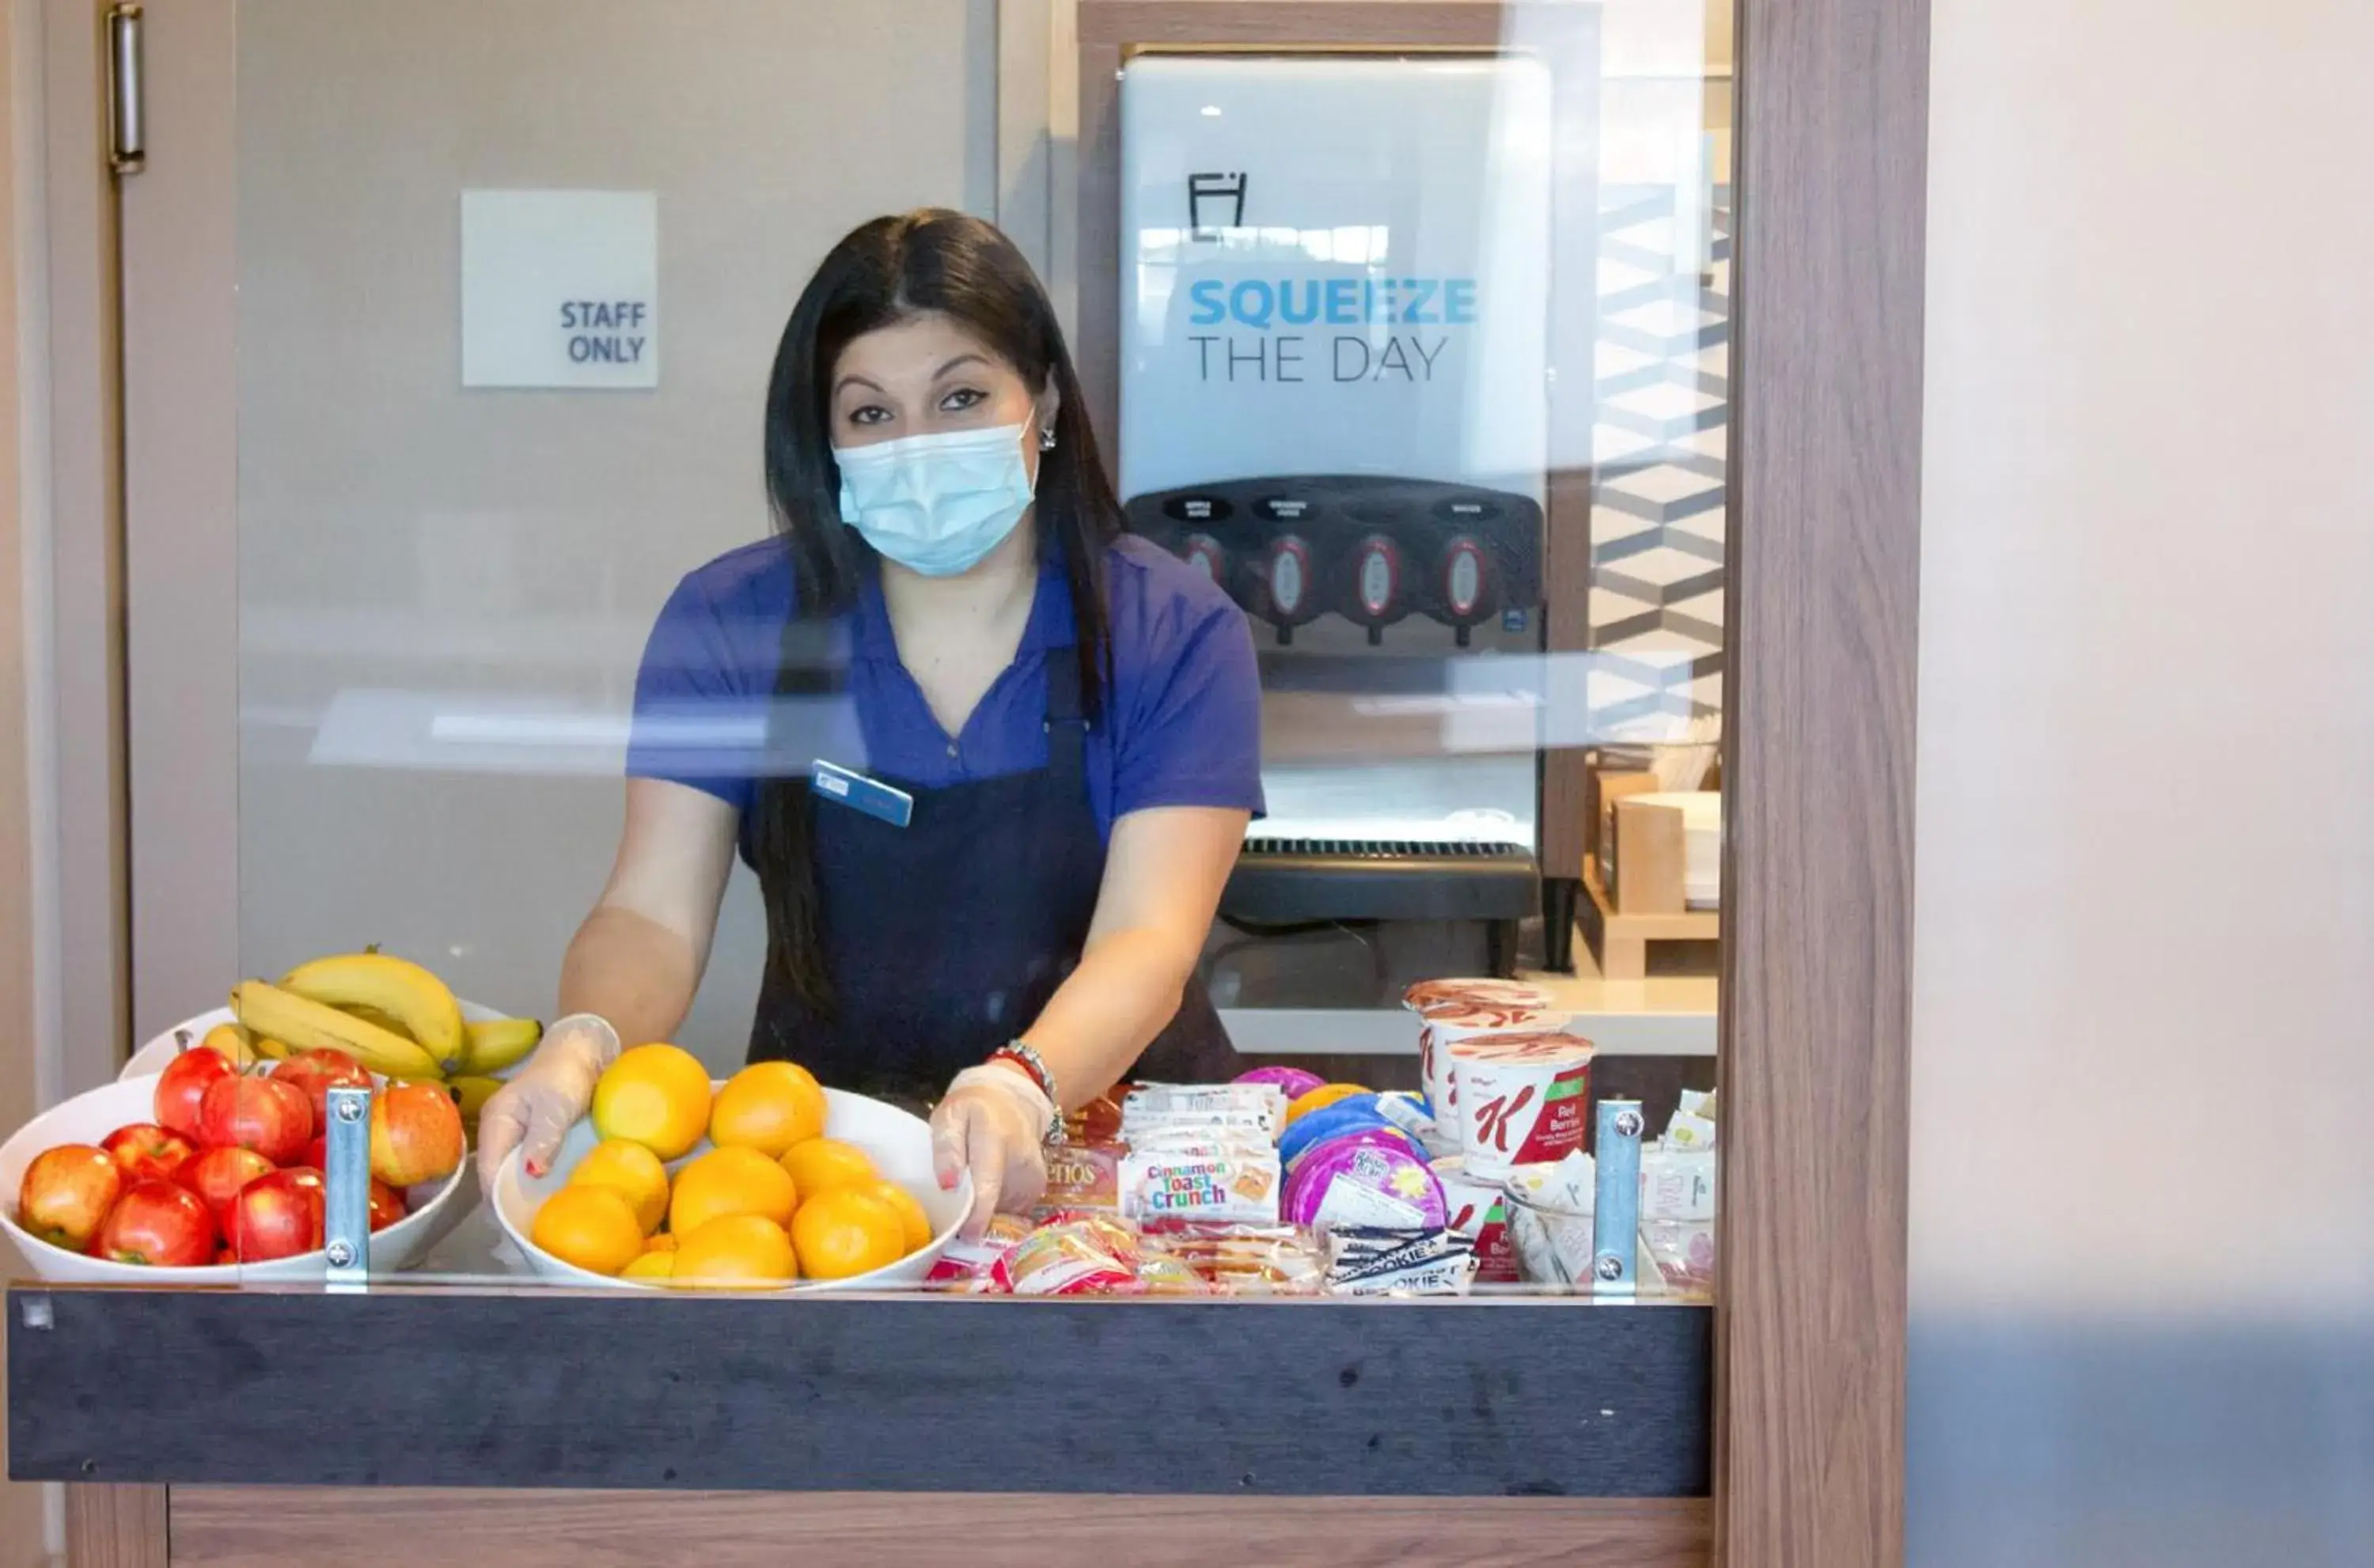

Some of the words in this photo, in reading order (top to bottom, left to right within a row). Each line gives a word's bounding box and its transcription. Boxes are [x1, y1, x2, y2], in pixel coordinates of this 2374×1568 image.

[560, 301, 647, 329] STAFF
[1189, 278, 1477, 329] SQUEEZE
[568, 335, 646, 363] ONLY
[1188, 335, 1305, 382] THE
[1333, 335, 1449, 382] DAY
[1474, 1084, 1537, 1153] K
[1147, 1162, 1226, 1180] Cinnamon
[1163, 1173, 1212, 1192] Toast
[1152, 1184, 1226, 1210] Crunch
